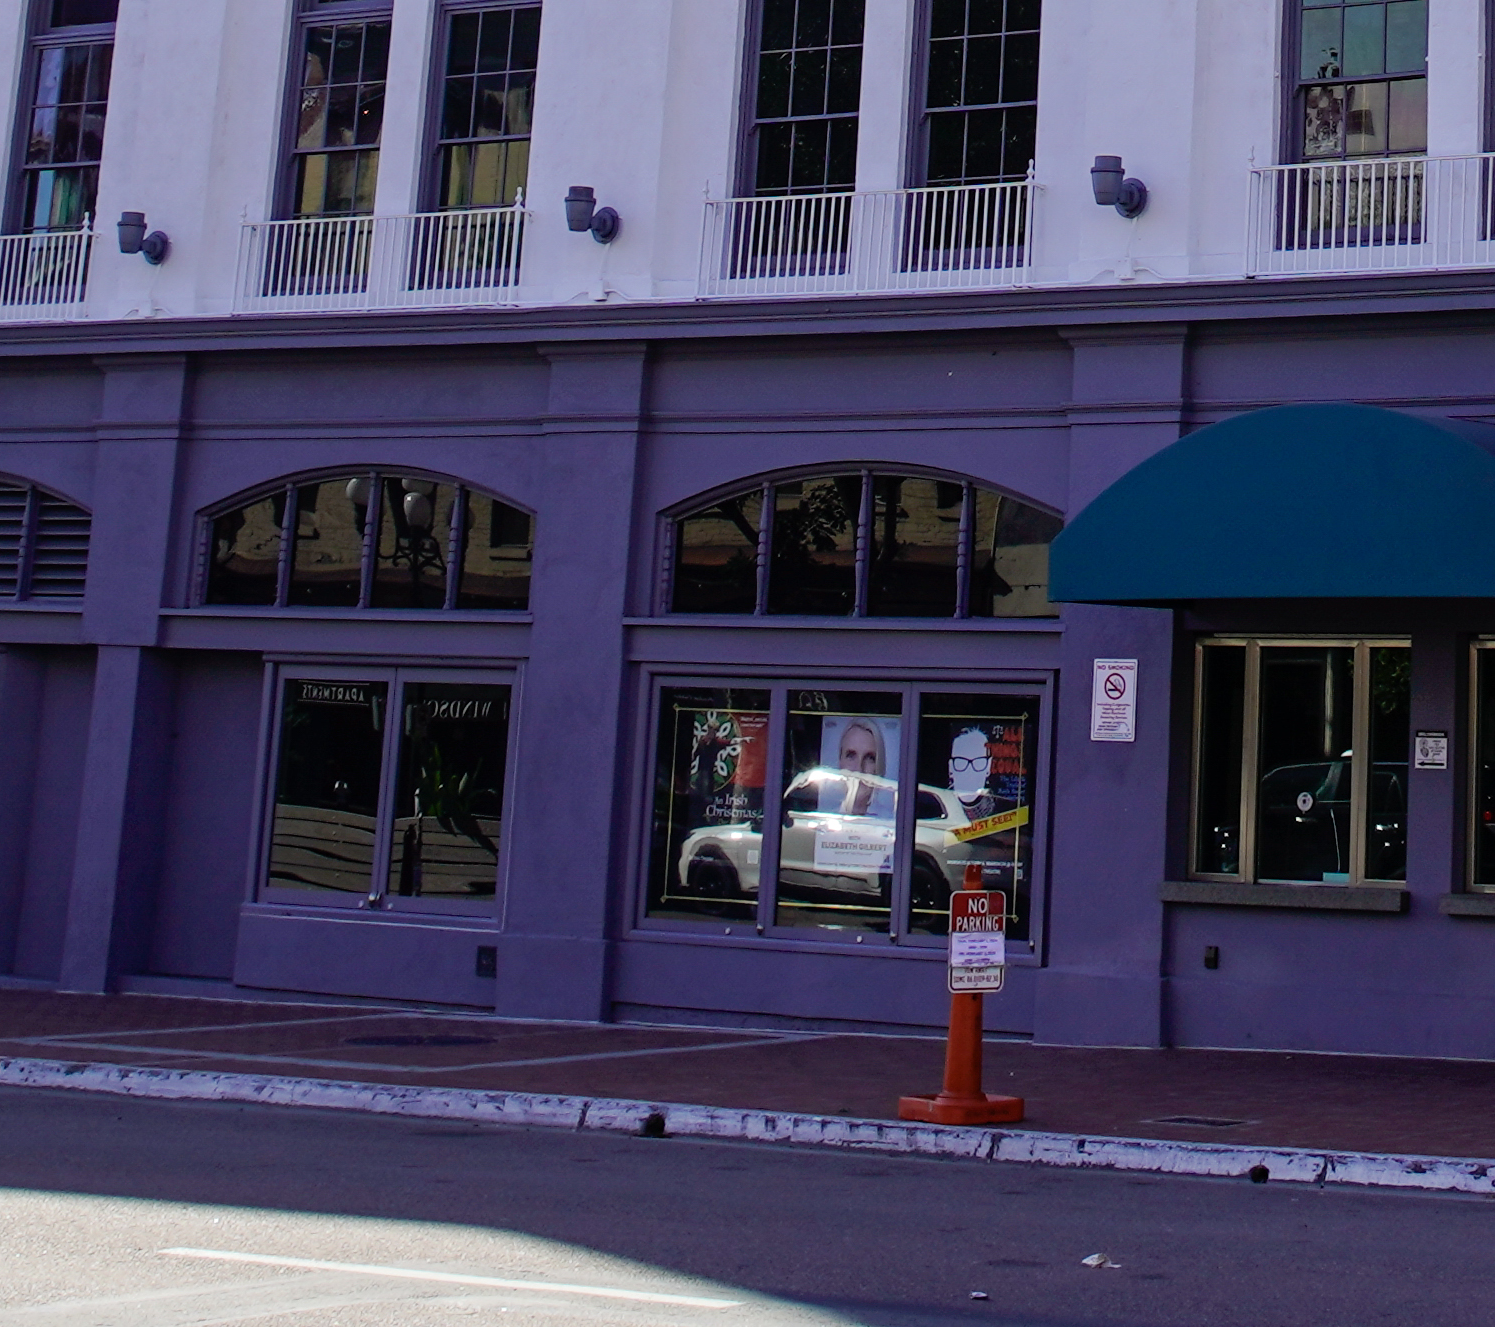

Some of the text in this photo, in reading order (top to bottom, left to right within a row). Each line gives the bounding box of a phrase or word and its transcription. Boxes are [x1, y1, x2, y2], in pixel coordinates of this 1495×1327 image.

[725, 793, 748, 807] Irish
[963, 819, 988, 835] MUST
[821, 841, 887, 851] ELIZABETH GILBERT
[968, 897, 987, 914] NO
[956, 916, 999, 931] PARKING
